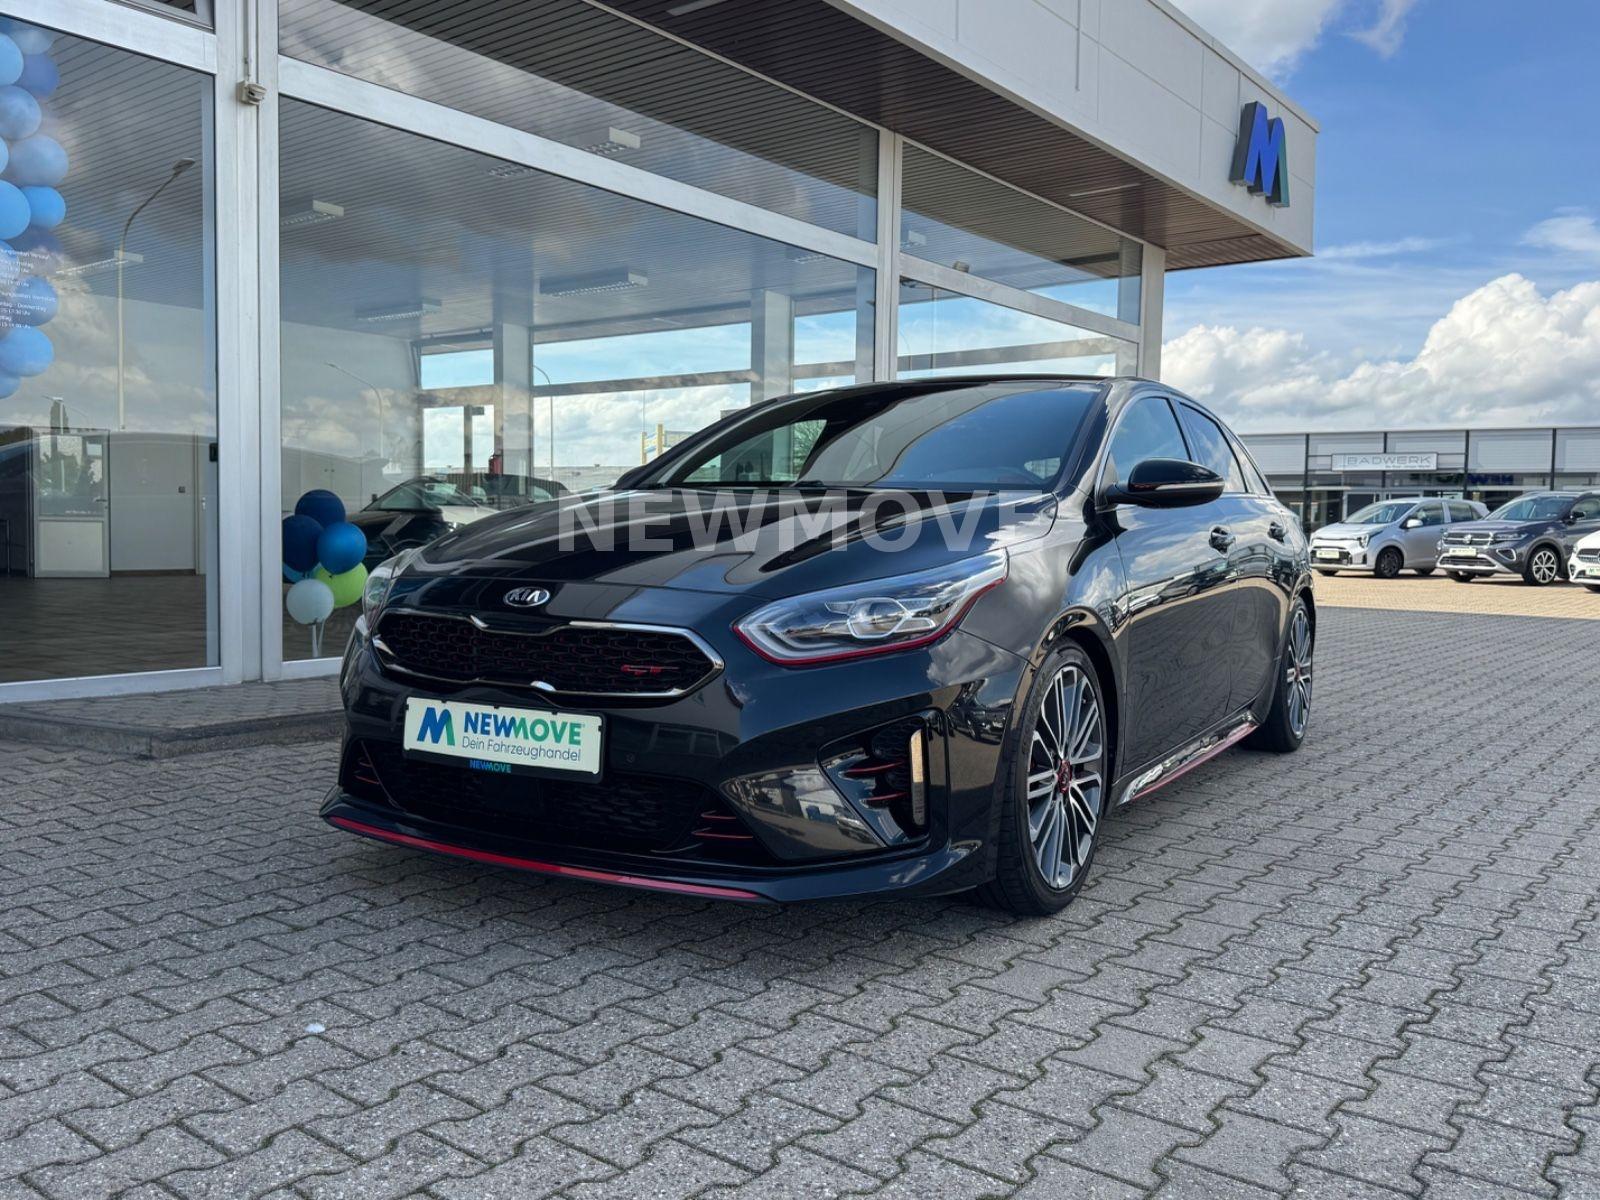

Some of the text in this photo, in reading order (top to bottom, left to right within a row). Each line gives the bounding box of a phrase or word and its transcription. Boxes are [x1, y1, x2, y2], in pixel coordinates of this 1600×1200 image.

[508, 587, 543, 604] KIA
[464, 711, 582, 745] NEWMOVE
[462, 736, 581, 762] Dein Fahrzeughandel
[469, 759, 511, 773] NEWMOVE
